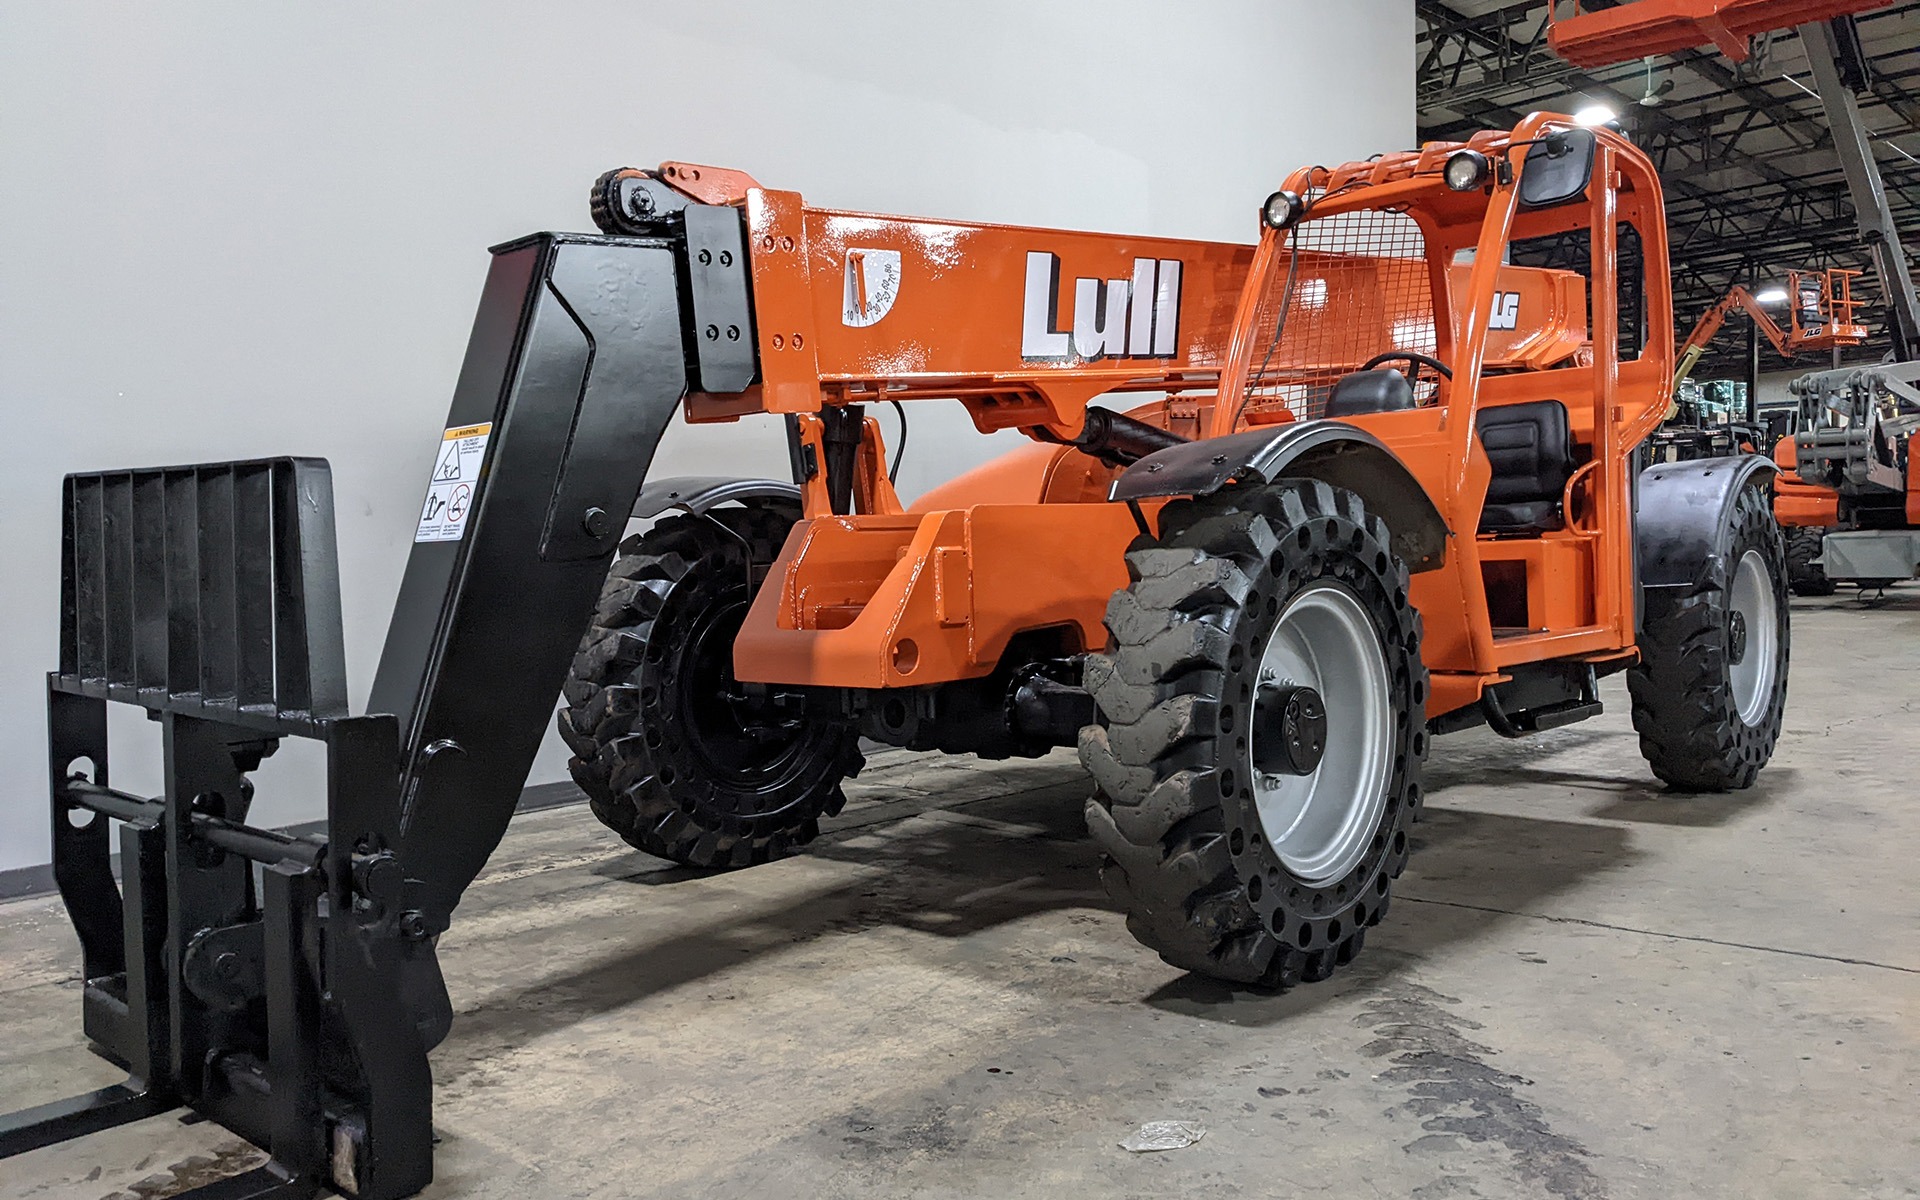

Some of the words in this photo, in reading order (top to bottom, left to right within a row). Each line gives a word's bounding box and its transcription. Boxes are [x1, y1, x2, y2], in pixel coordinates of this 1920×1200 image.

[1022, 251, 1183, 361] Lull
[1488, 290, 1521, 331] LG
[1804, 328, 1822, 338] JLG
